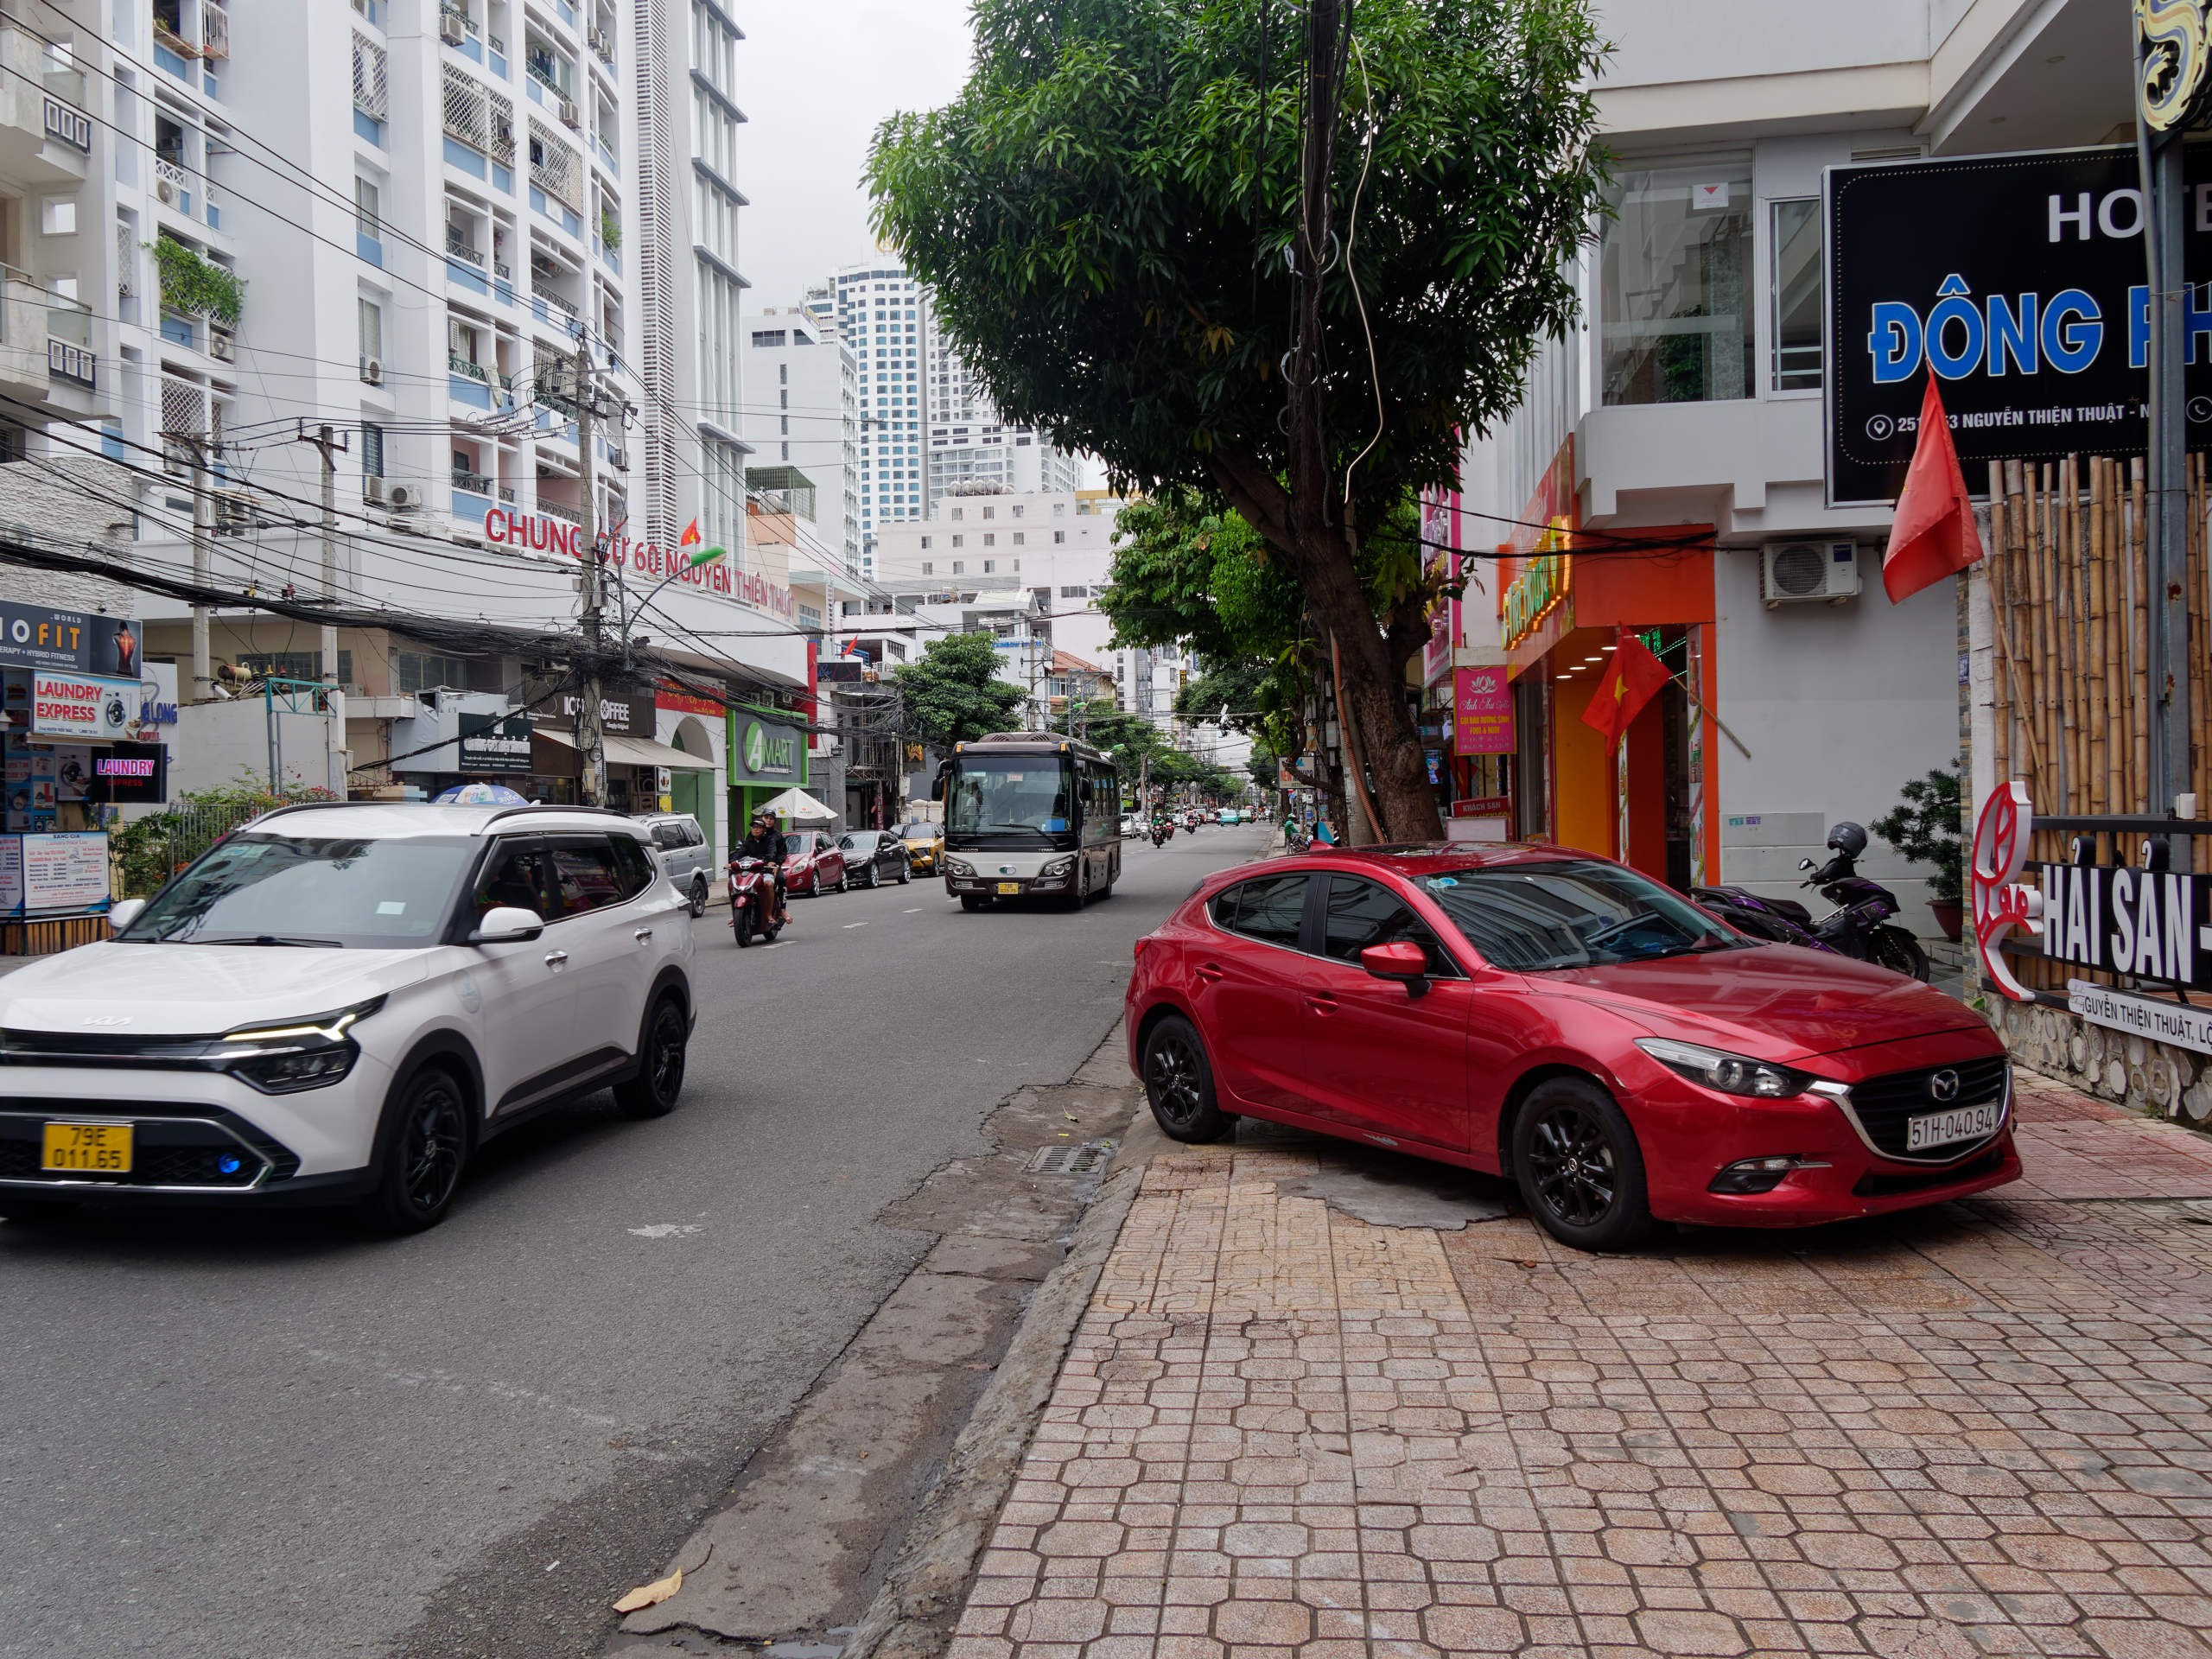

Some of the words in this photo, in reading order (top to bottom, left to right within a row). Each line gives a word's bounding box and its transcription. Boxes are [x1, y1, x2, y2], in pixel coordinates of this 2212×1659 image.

[2048, 182, 2212, 243] HOE
[1868, 274, 2103, 383] ĐÔNG
[1962, 406, 2024, 429] NGUYỄN
[2028, 405, 2072, 427] THIỆN
[2077, 403, 2125, 422] THUẬT
[486, 508, 582, 559] CHUNG
[634, 542, 659, 575] 60
[734, 569, 768, 610] THIỆN
[27, 649, 49, 658] HYBRID
[50, 652, 76, 662] FITNESS
[36, 680, 103, 702] LAUNDRY
[36, 702, 96, 721] EXPRESS
[600, 698, 630, 721] OFFEE
[97, 760, 155, 776] LAUNDRY
[2043, 836, 2101, 966] HẢI
[2111, 839, 2192, 983] SẢN
[2082, 995, 2118, 1020] GUYỄN
[2120, 1004, 2152, 1031] THIỆN
[69, 1127, 108, 1147] 79E
[1911, 1107, 1993, 1146] 51H-040.94
[53, 1148, 122, 1169] 011.65
